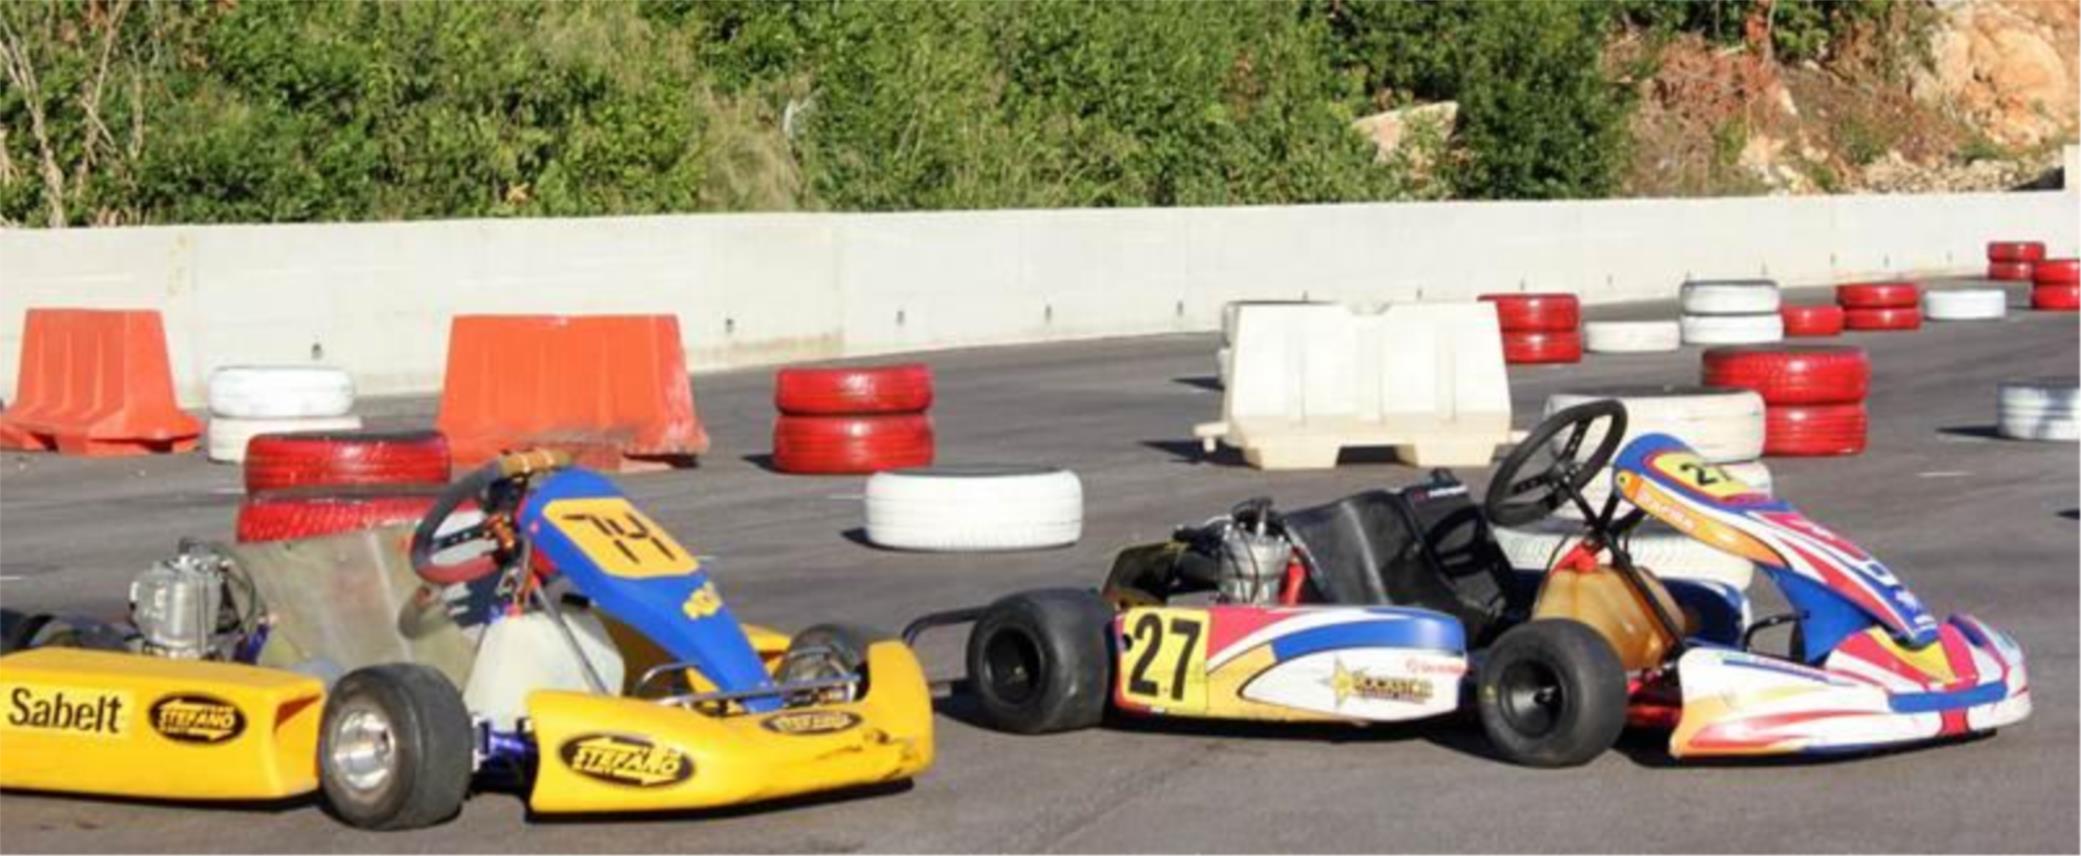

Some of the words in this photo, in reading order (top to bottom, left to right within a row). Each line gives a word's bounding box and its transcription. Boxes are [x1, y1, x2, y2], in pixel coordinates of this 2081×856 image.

[561, 512, 678, 564] 74
[1128, 613, 1202, 701] 27
[8, 686, 122, 734] Sabelt
[573, 744, 680, 777] STEFANO
